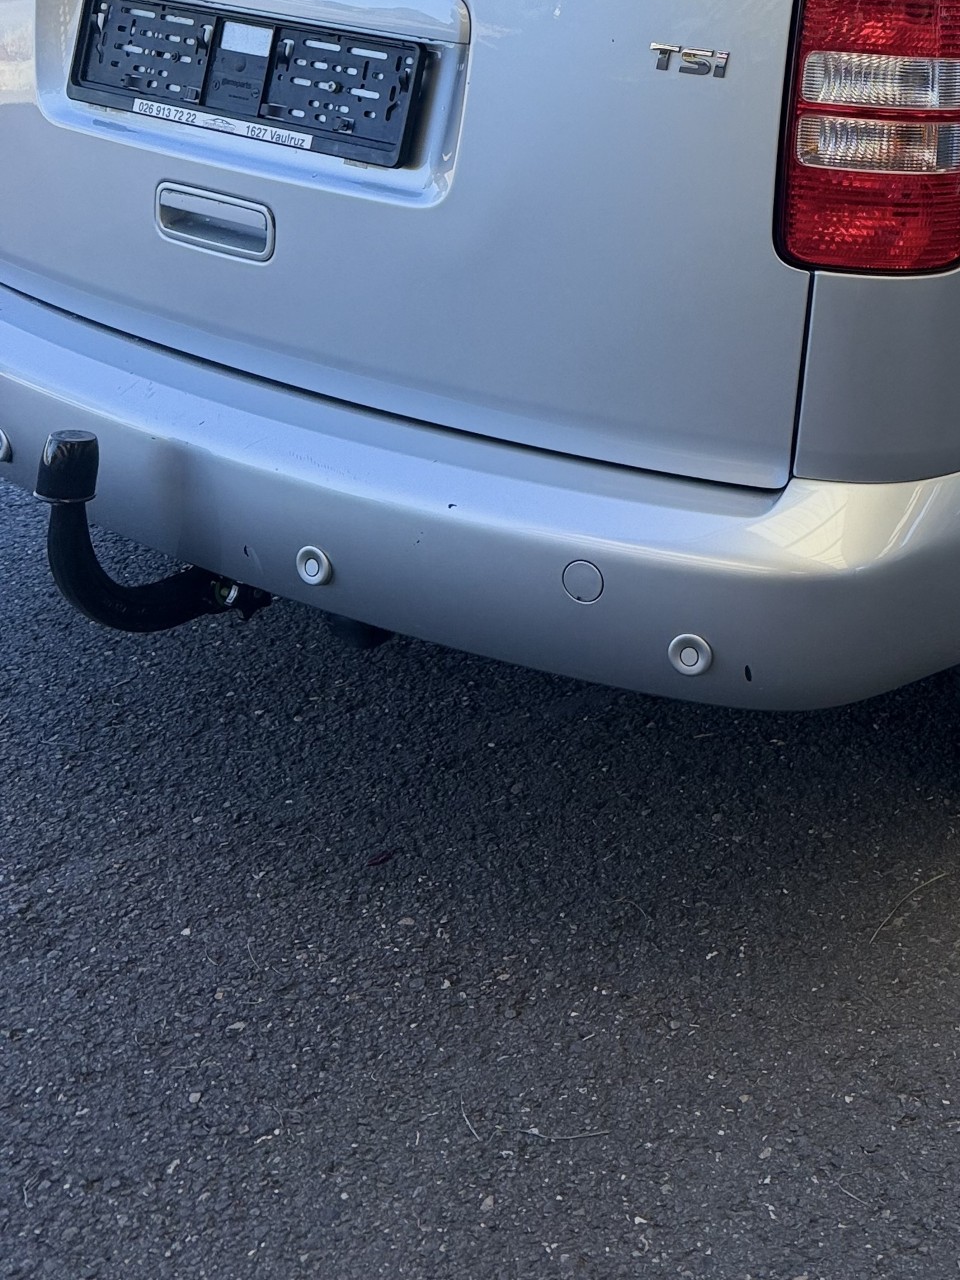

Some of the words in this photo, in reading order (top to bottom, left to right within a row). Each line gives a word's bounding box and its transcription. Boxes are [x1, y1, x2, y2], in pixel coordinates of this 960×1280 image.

[138, 101, 154, 114] 026
[155, 105, 171, 118] 913
[173, 109, 184, 121] 72
[185, 112, 197, 123] 22
[246, 124, 267, 138] 1627
[270, 129, 305, 147] Vaulruz
